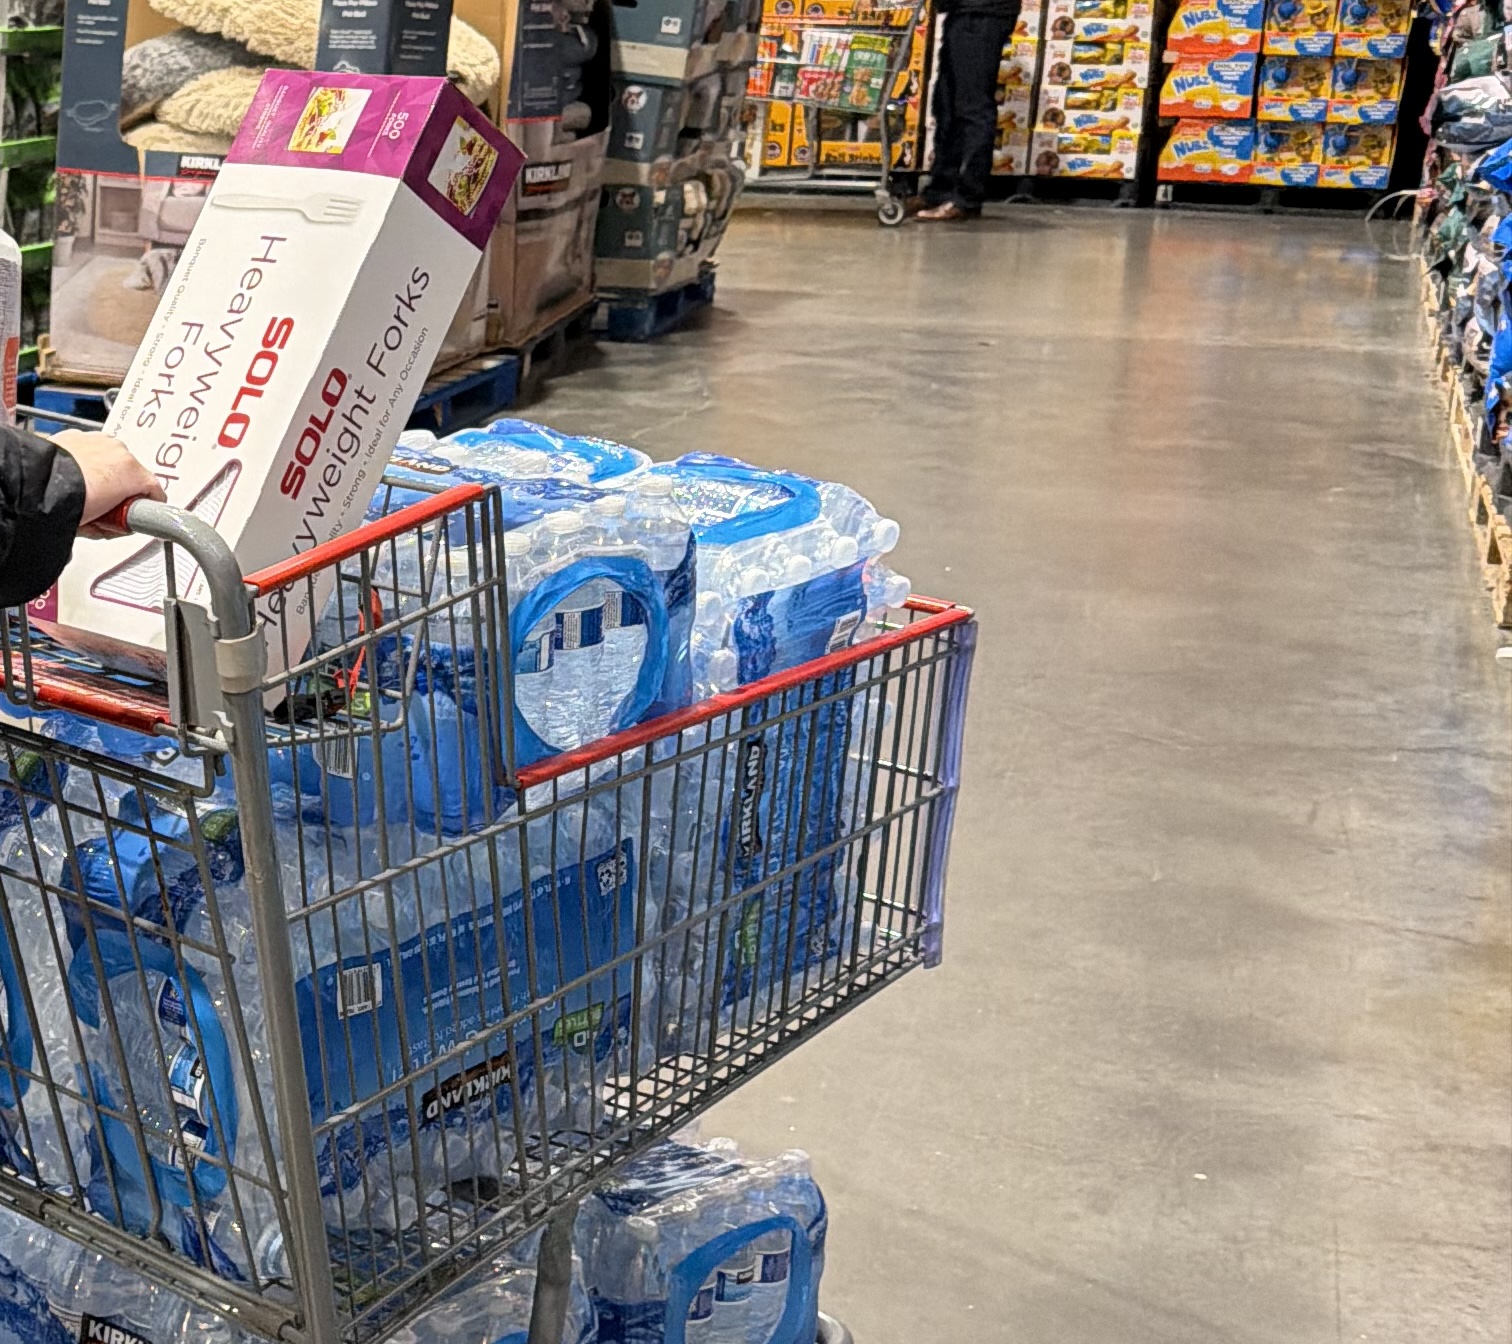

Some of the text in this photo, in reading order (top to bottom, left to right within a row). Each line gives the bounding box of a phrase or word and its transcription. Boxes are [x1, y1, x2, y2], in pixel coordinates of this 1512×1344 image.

[389, 111, 409, 140] 500
[180, 155, 221, 170] KIRKL
[184, 237, 207, 282] Banquet
[164, 283, 186, 323] Quality
[366, 265, 431, 378] Forks
[142, 332, 165, 368] Strong
[154, 234, 287, 489] Heavyweigh
[127, 376, 144, 403] Ideal
[136, 321, 204, 429] Forks
[217, 316, 295, 449] SOLO
[120, 404, 132, 422] for
[280, 367, 348, 500] SOLO
[342, 467, 367, 511] Strong
[364, 427, 384, 463] Ideal
[380, 409, 392, 426] for
[386, 384, 405, 410] Any
[400, 326, 429, 382] Occasion
